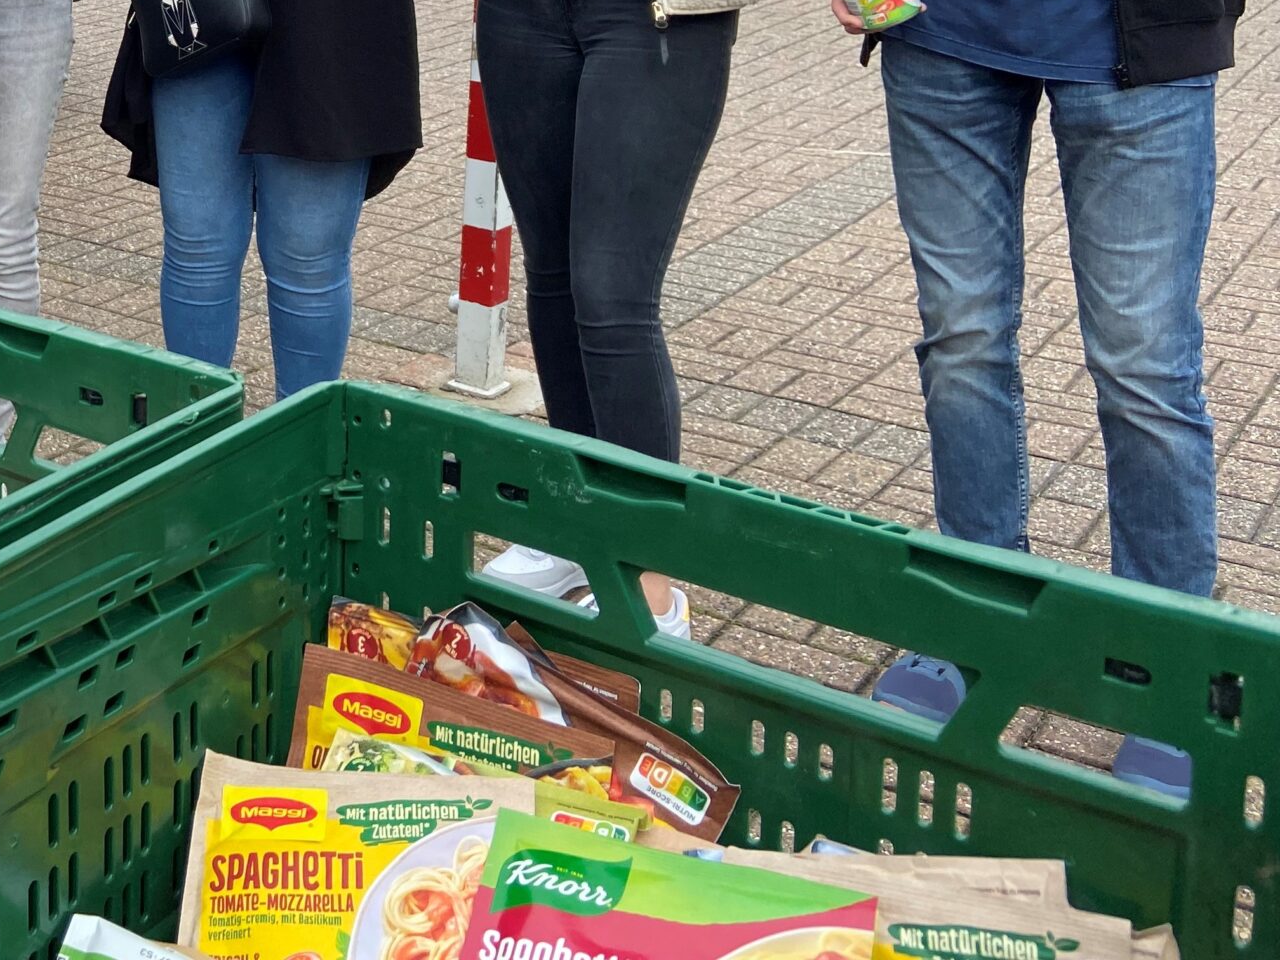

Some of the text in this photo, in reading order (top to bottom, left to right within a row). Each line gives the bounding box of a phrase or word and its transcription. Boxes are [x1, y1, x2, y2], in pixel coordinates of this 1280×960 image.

[342, 697, 404, 730] Maggi
[435, 724, 540, 767] Mit natürlichen
[240, 803, 308, 819] Maggi
[346, 803, 459, 821] Mit natürlichen
[646, 786, 696, 821] NUTRI-SCORE
[506, 858, 613, 906] Knorr
[208, 913, 342, 928] Tomatig-cremig, mit Basilikum
[208, 926, 252, 941] verfeinert
[899, 927, 1038, 960] Mit natürlichen
